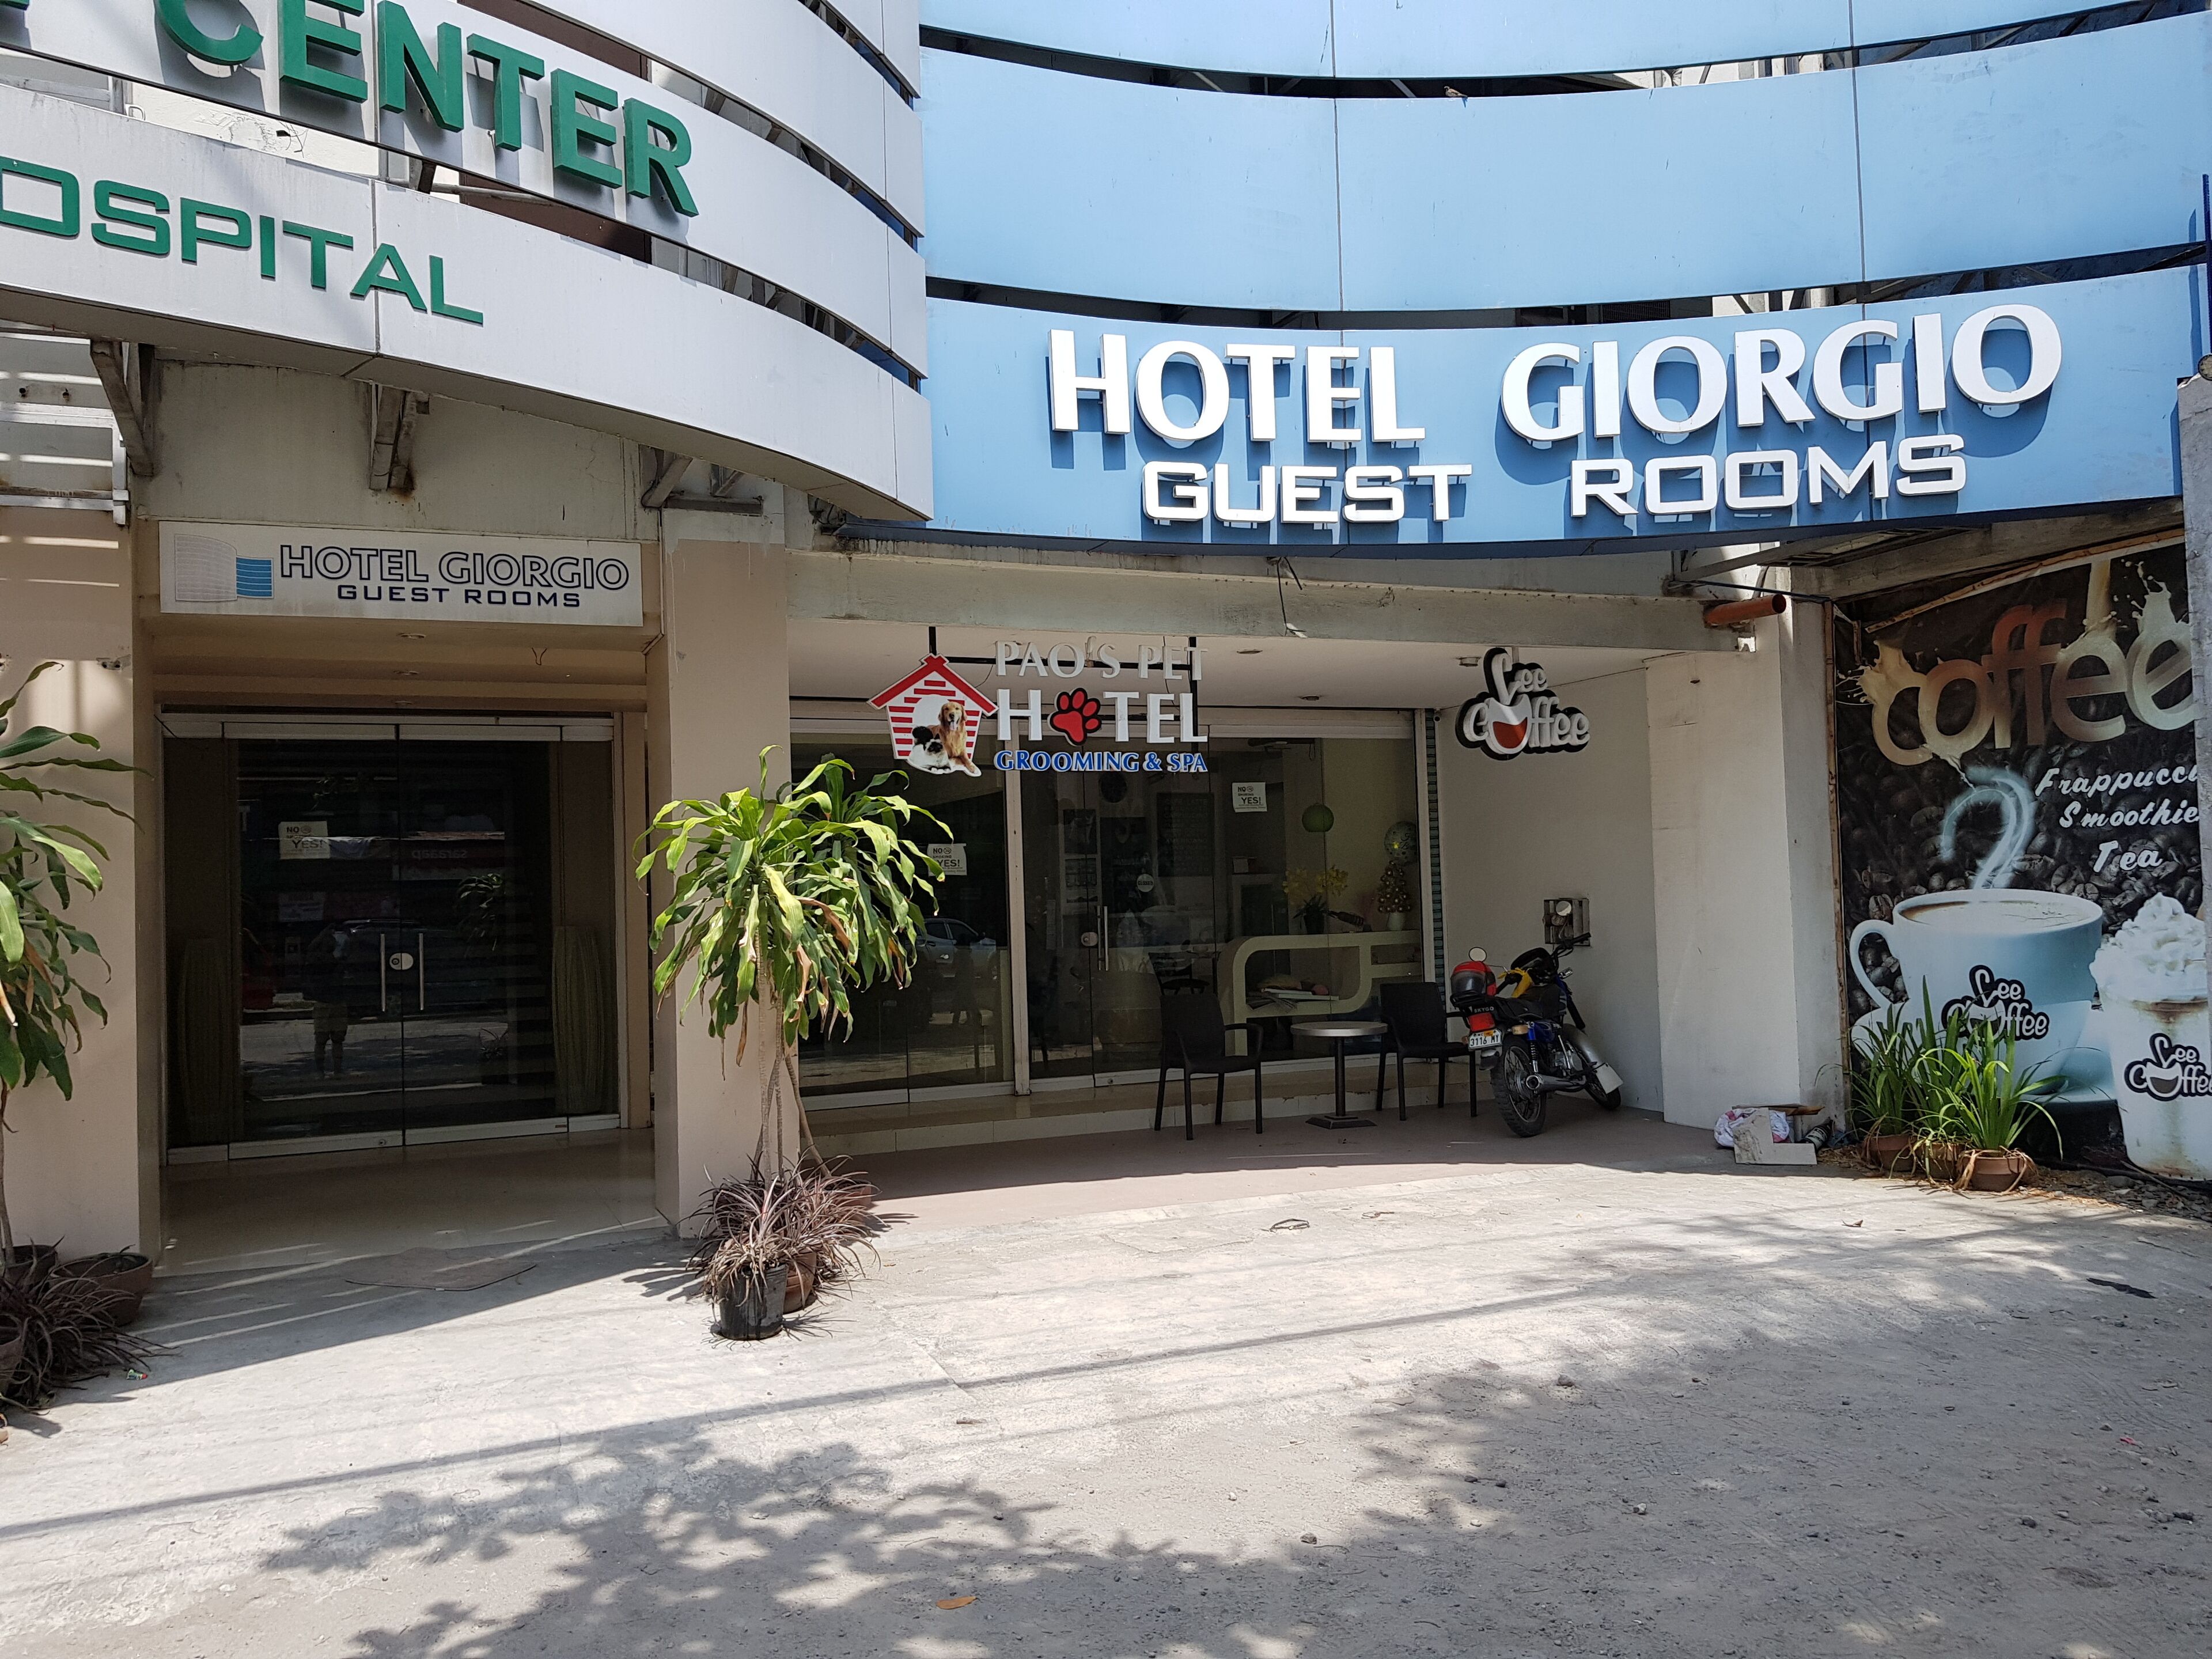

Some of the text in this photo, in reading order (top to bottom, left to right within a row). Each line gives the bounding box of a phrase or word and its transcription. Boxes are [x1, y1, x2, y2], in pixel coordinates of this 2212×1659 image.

[1048, 304, 2062, 442] HOTEL GIORGIO
[1142, 434, 1965, 524] GUEST ROOMS
[281, 545, 629, 590] HOTEL GIORGIO
[338, 585, 580, 608] GUEST ROOMS
[995, 636, 1208, 681] PAO'S PET
[994, 749, 1208, 772] GROOMING & SPA
[2059, 798, 2200, 829] Smoothie
[2093, 840, 2163, 873] Tea
[1470, 1037, 1487, 1047] 3116
